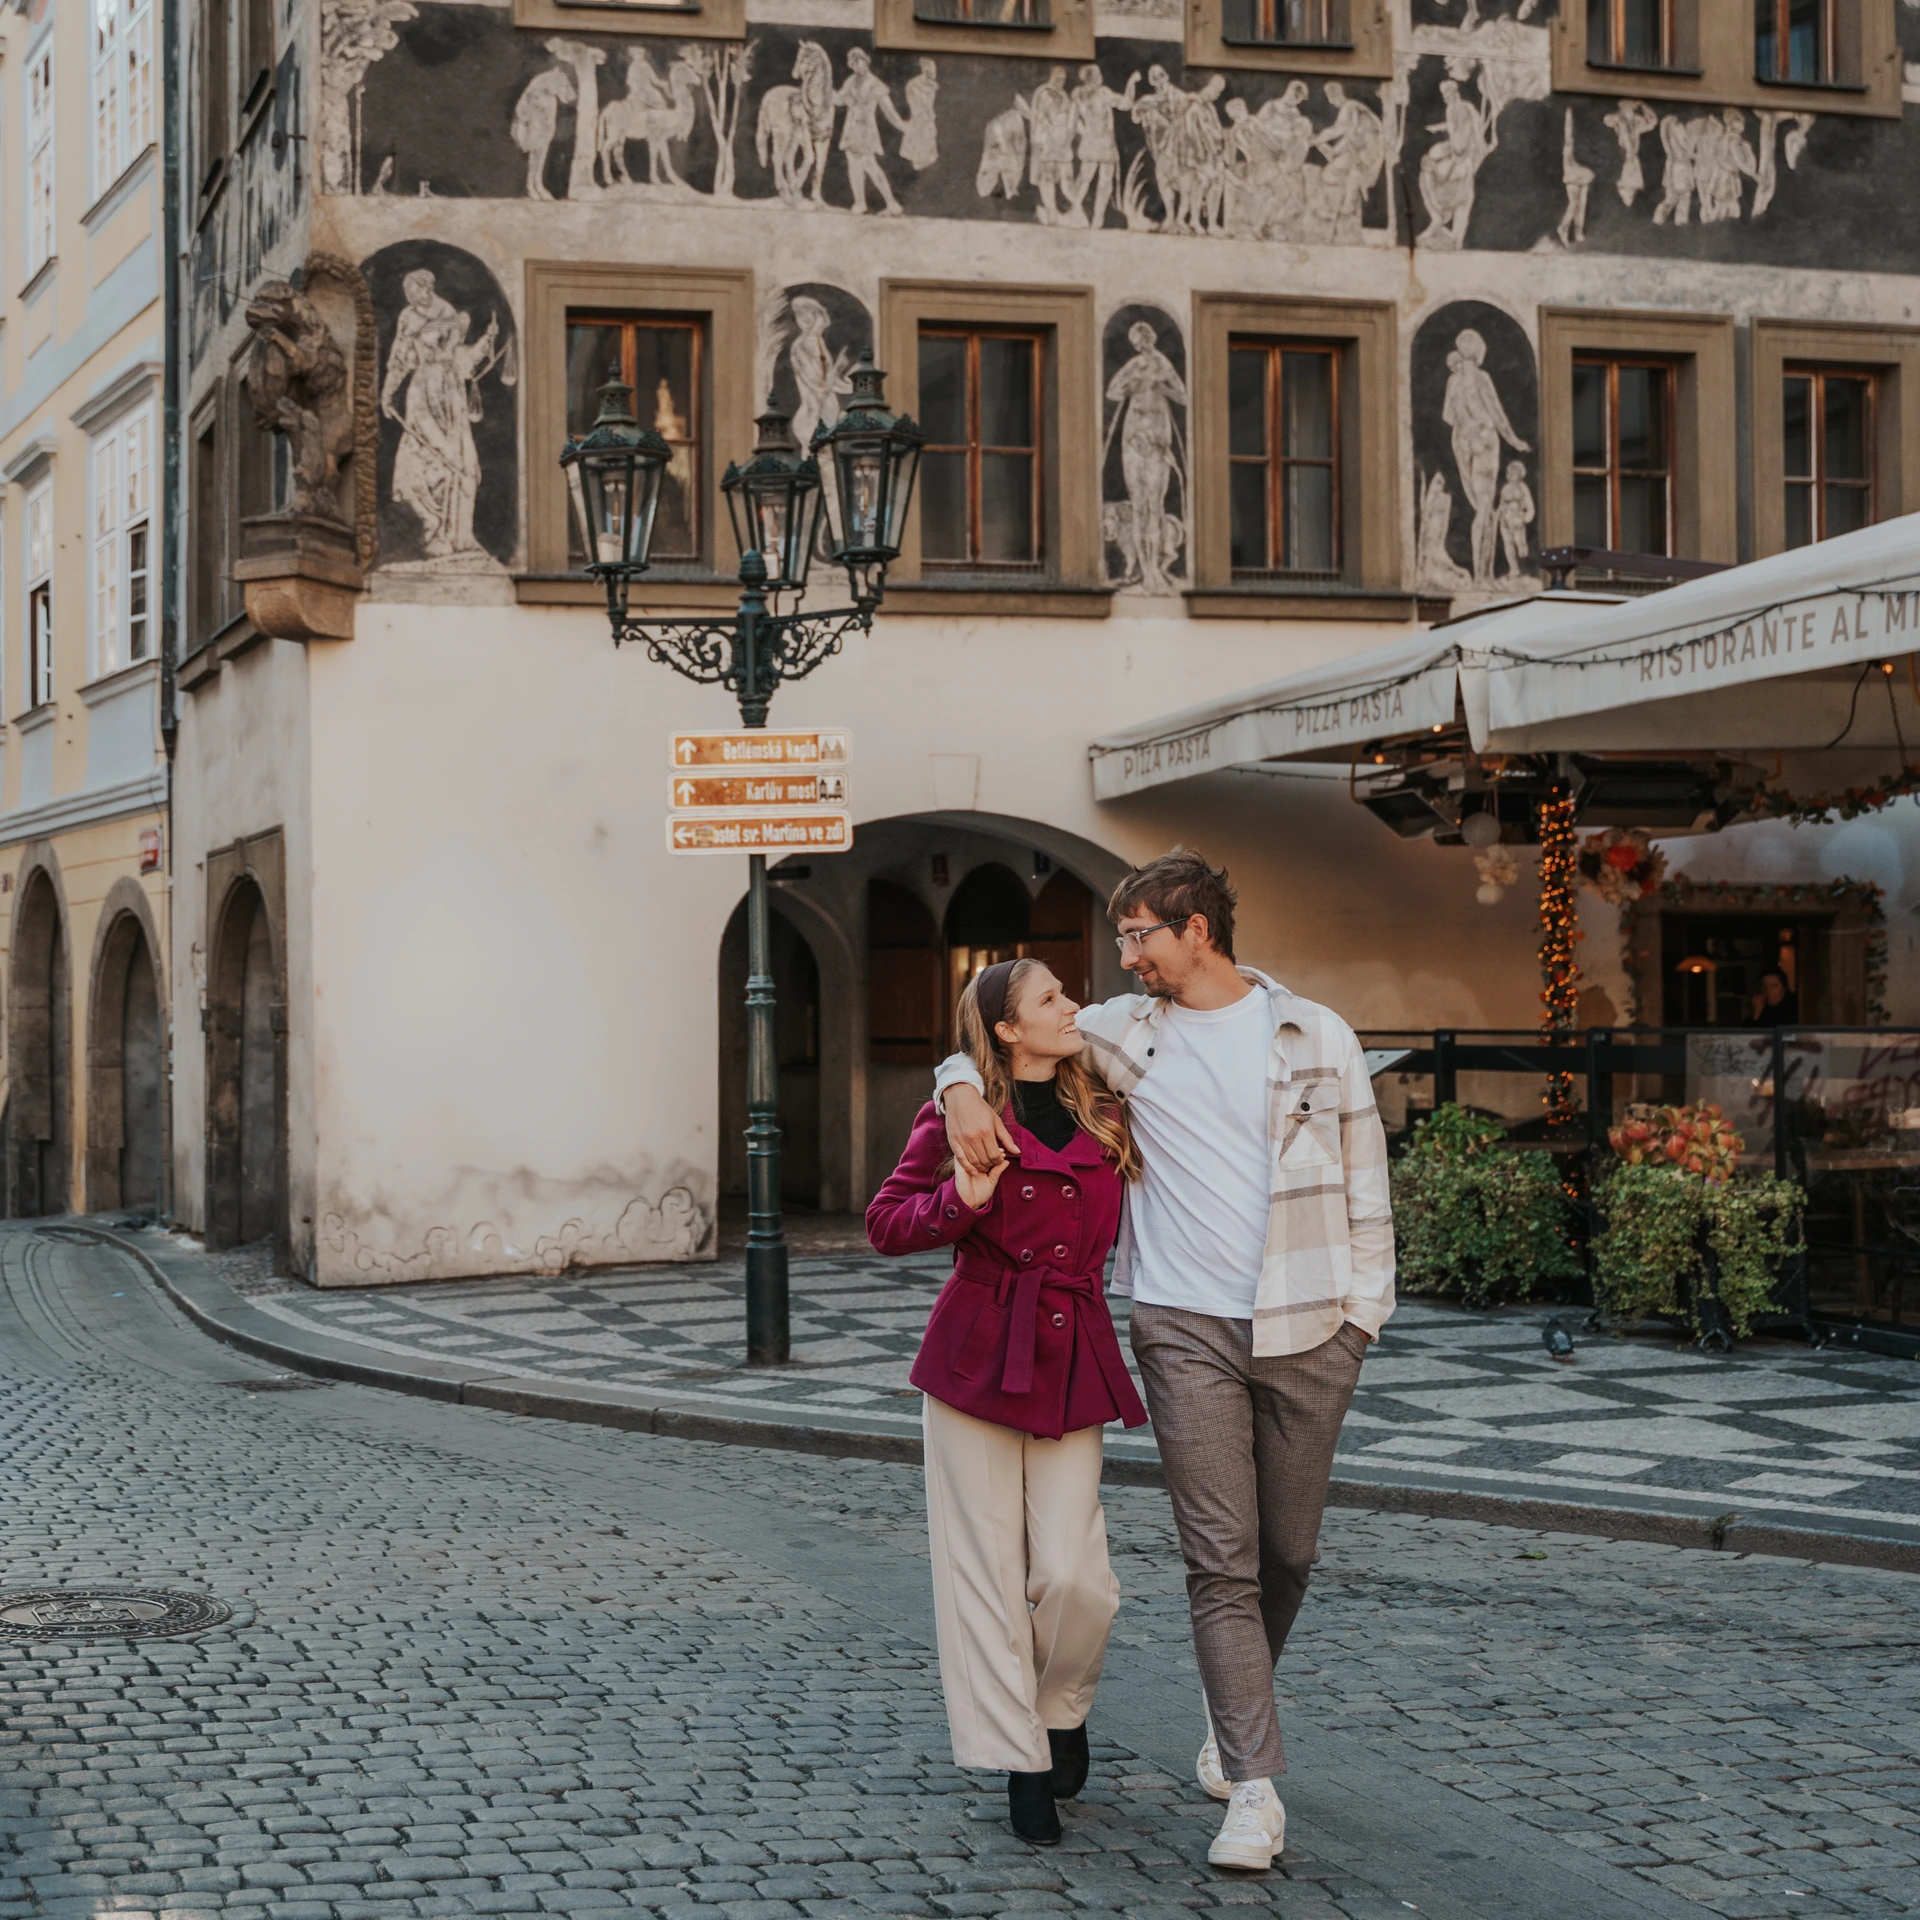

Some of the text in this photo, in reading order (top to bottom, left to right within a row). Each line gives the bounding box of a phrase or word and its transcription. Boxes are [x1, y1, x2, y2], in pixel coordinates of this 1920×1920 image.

[1640, 612, 1817, 683] RISTORANTE
[1830, 602, 1869, 645] AL
[1295, 688, 1404, 736] PIZZA PASTA
[723, 739, 818, 762] Betlémská kaple
[1123, 732, 1211, 780] PIZZA PASTA
[787, 782, 817, 800] most
[710, 823, 741, 844] ostel
[762, 822, 808, 843] Martina
[809, 826, 824, 841] ve
[826, 820, 844, 840] zdi
